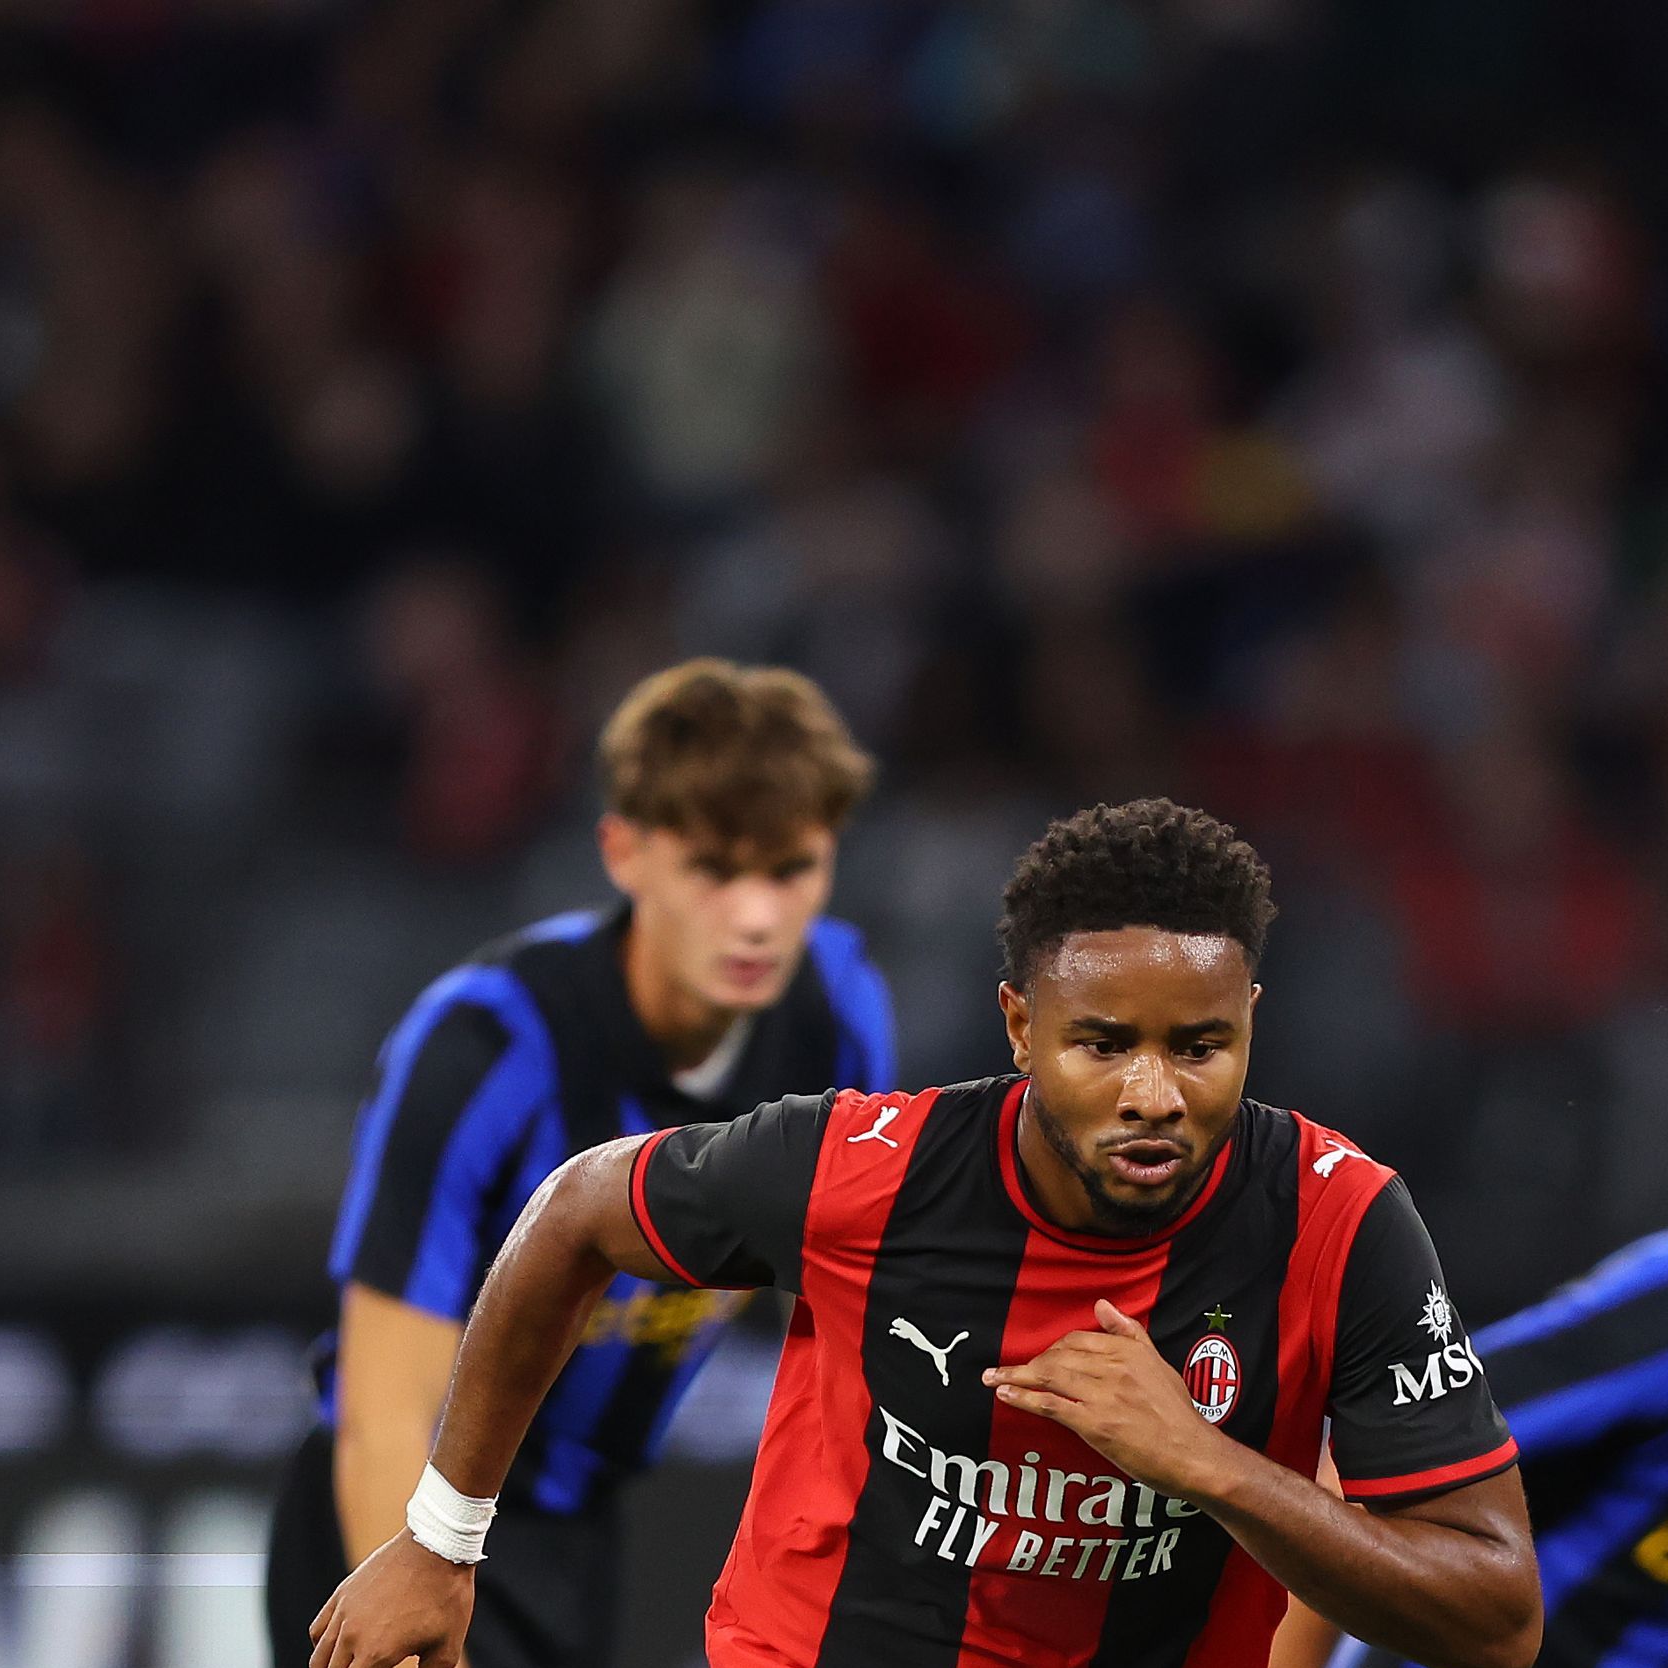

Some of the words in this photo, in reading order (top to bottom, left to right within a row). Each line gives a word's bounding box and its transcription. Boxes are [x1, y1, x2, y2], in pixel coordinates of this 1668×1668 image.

[1197, 1342, 1230, 1361] ACM
[878, 1405, 1202, 1528] Emirat
[914, 1495, 999, 1568] FLY
[1006, 1527, 1181, 1582] BETTER
